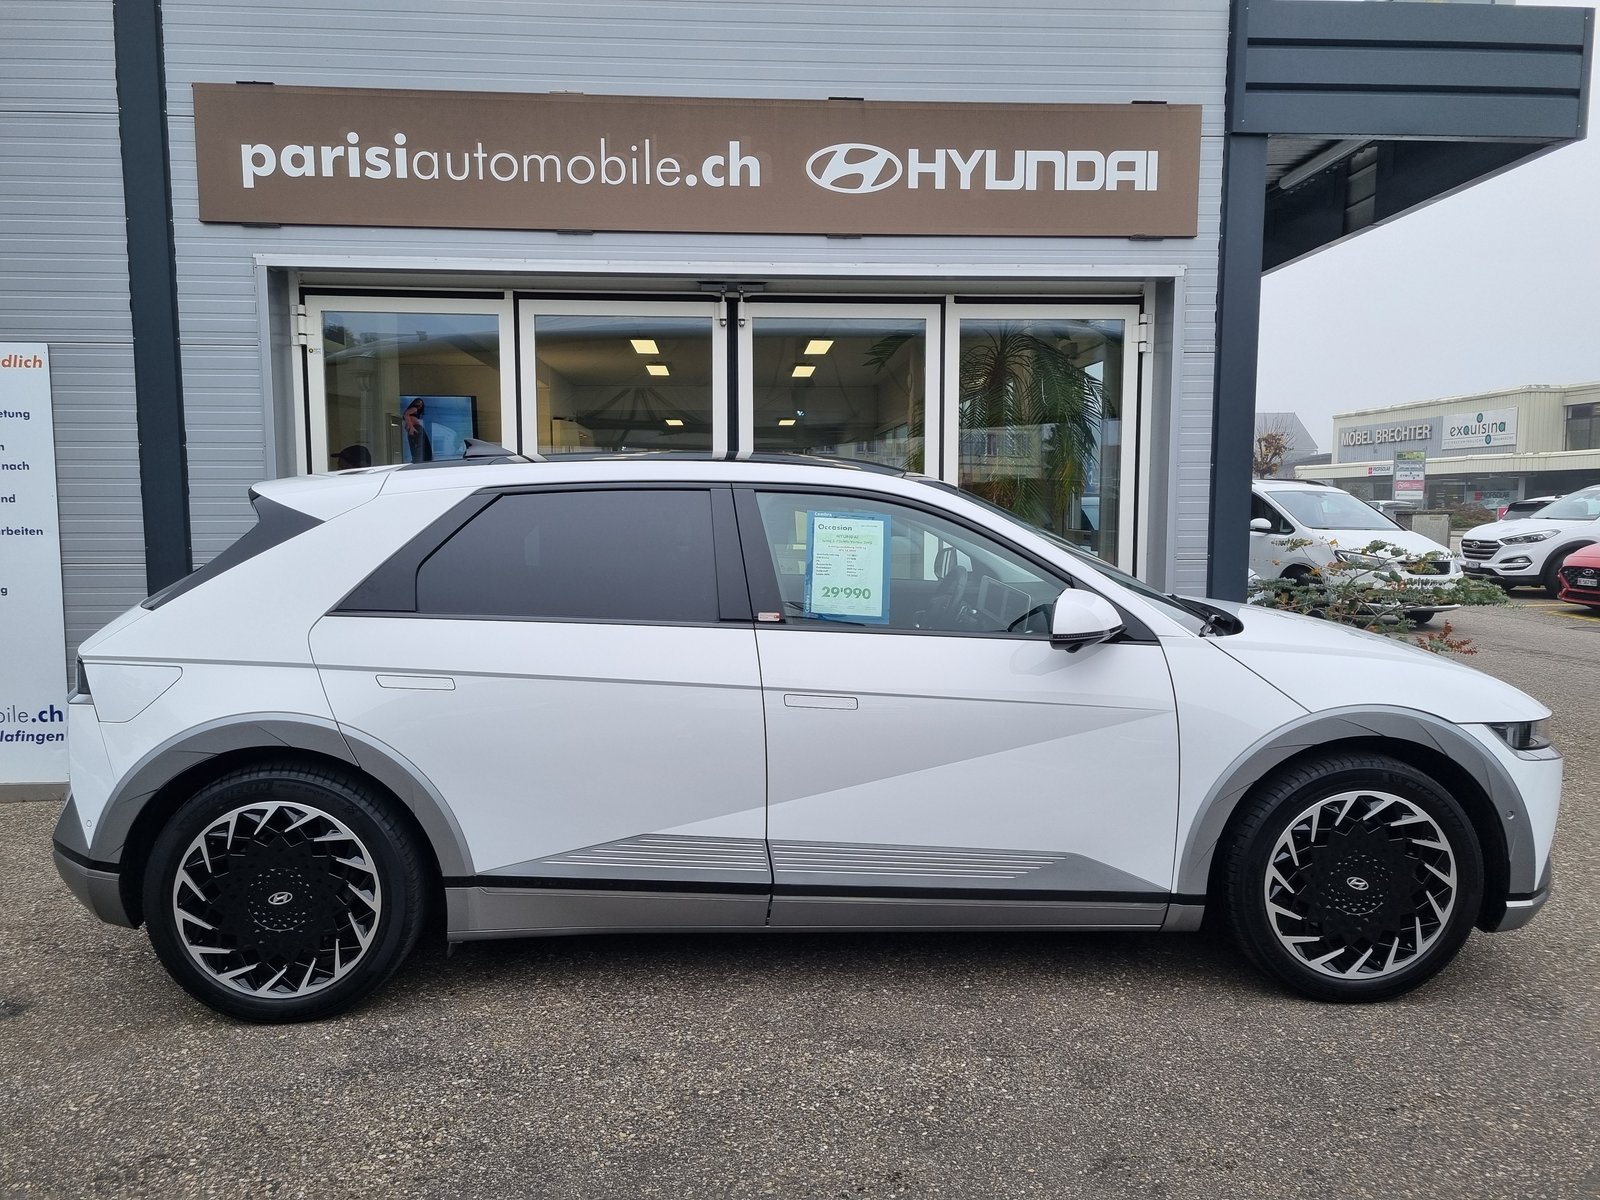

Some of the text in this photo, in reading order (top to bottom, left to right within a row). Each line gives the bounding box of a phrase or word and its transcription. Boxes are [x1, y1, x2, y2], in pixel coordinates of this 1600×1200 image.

[240, 131, 762, 189] parisiautomobile.ch
[907, 148, 1158, 192] HYUNDAI
[1, 354, 43, 369] dlich
[1450, 413, 1506, 437] exquisina
[1342, 424, 1432, 446] MÖBEL BRECHTER
[1, 461, 30, 471] nach
[818, 523, 853, 532] Occasion
[821, 586, 872, 600] 29'990
